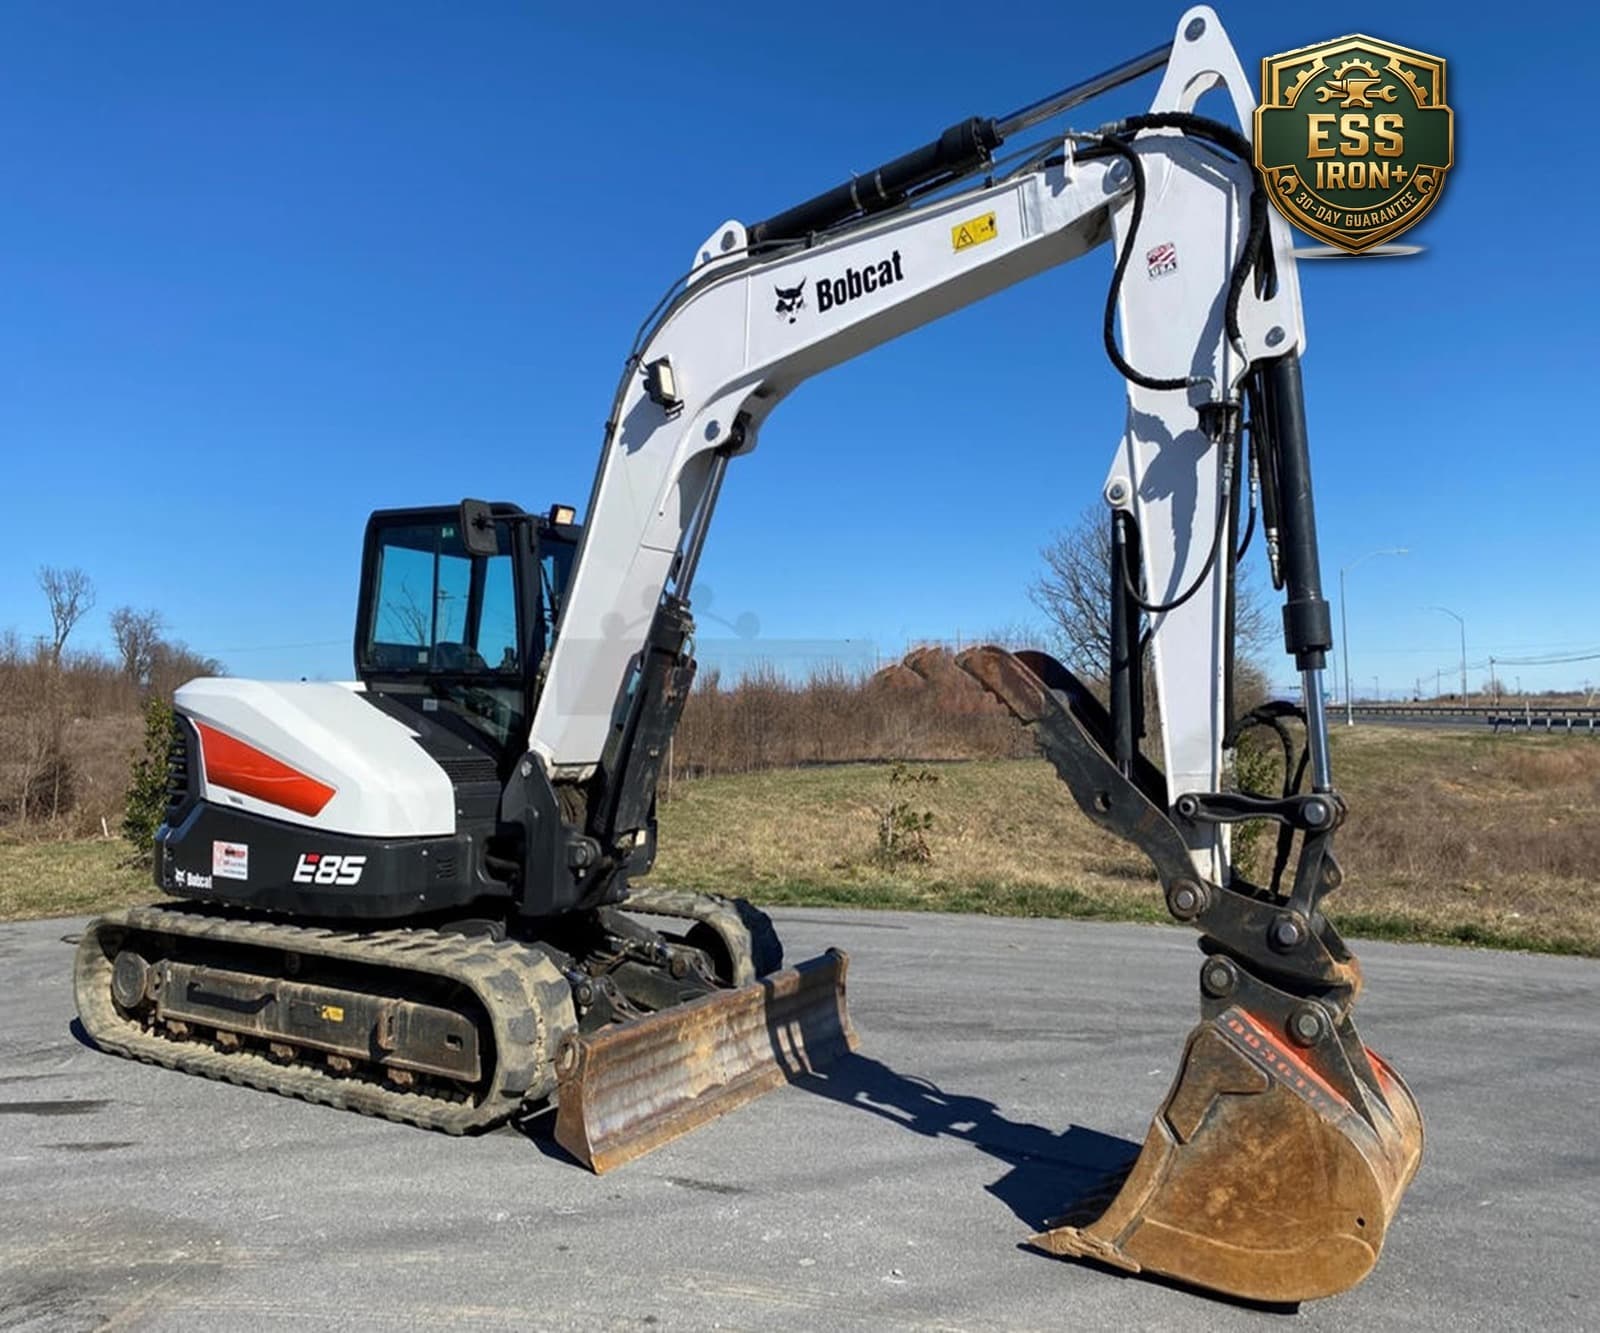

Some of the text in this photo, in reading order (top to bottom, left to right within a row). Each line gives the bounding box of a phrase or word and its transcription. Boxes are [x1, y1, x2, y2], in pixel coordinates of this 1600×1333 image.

[816, 250, 904, 313] Bobcat
[187, 871, 213, 889] Bobcat
[293, 852, 367, 886] E85
